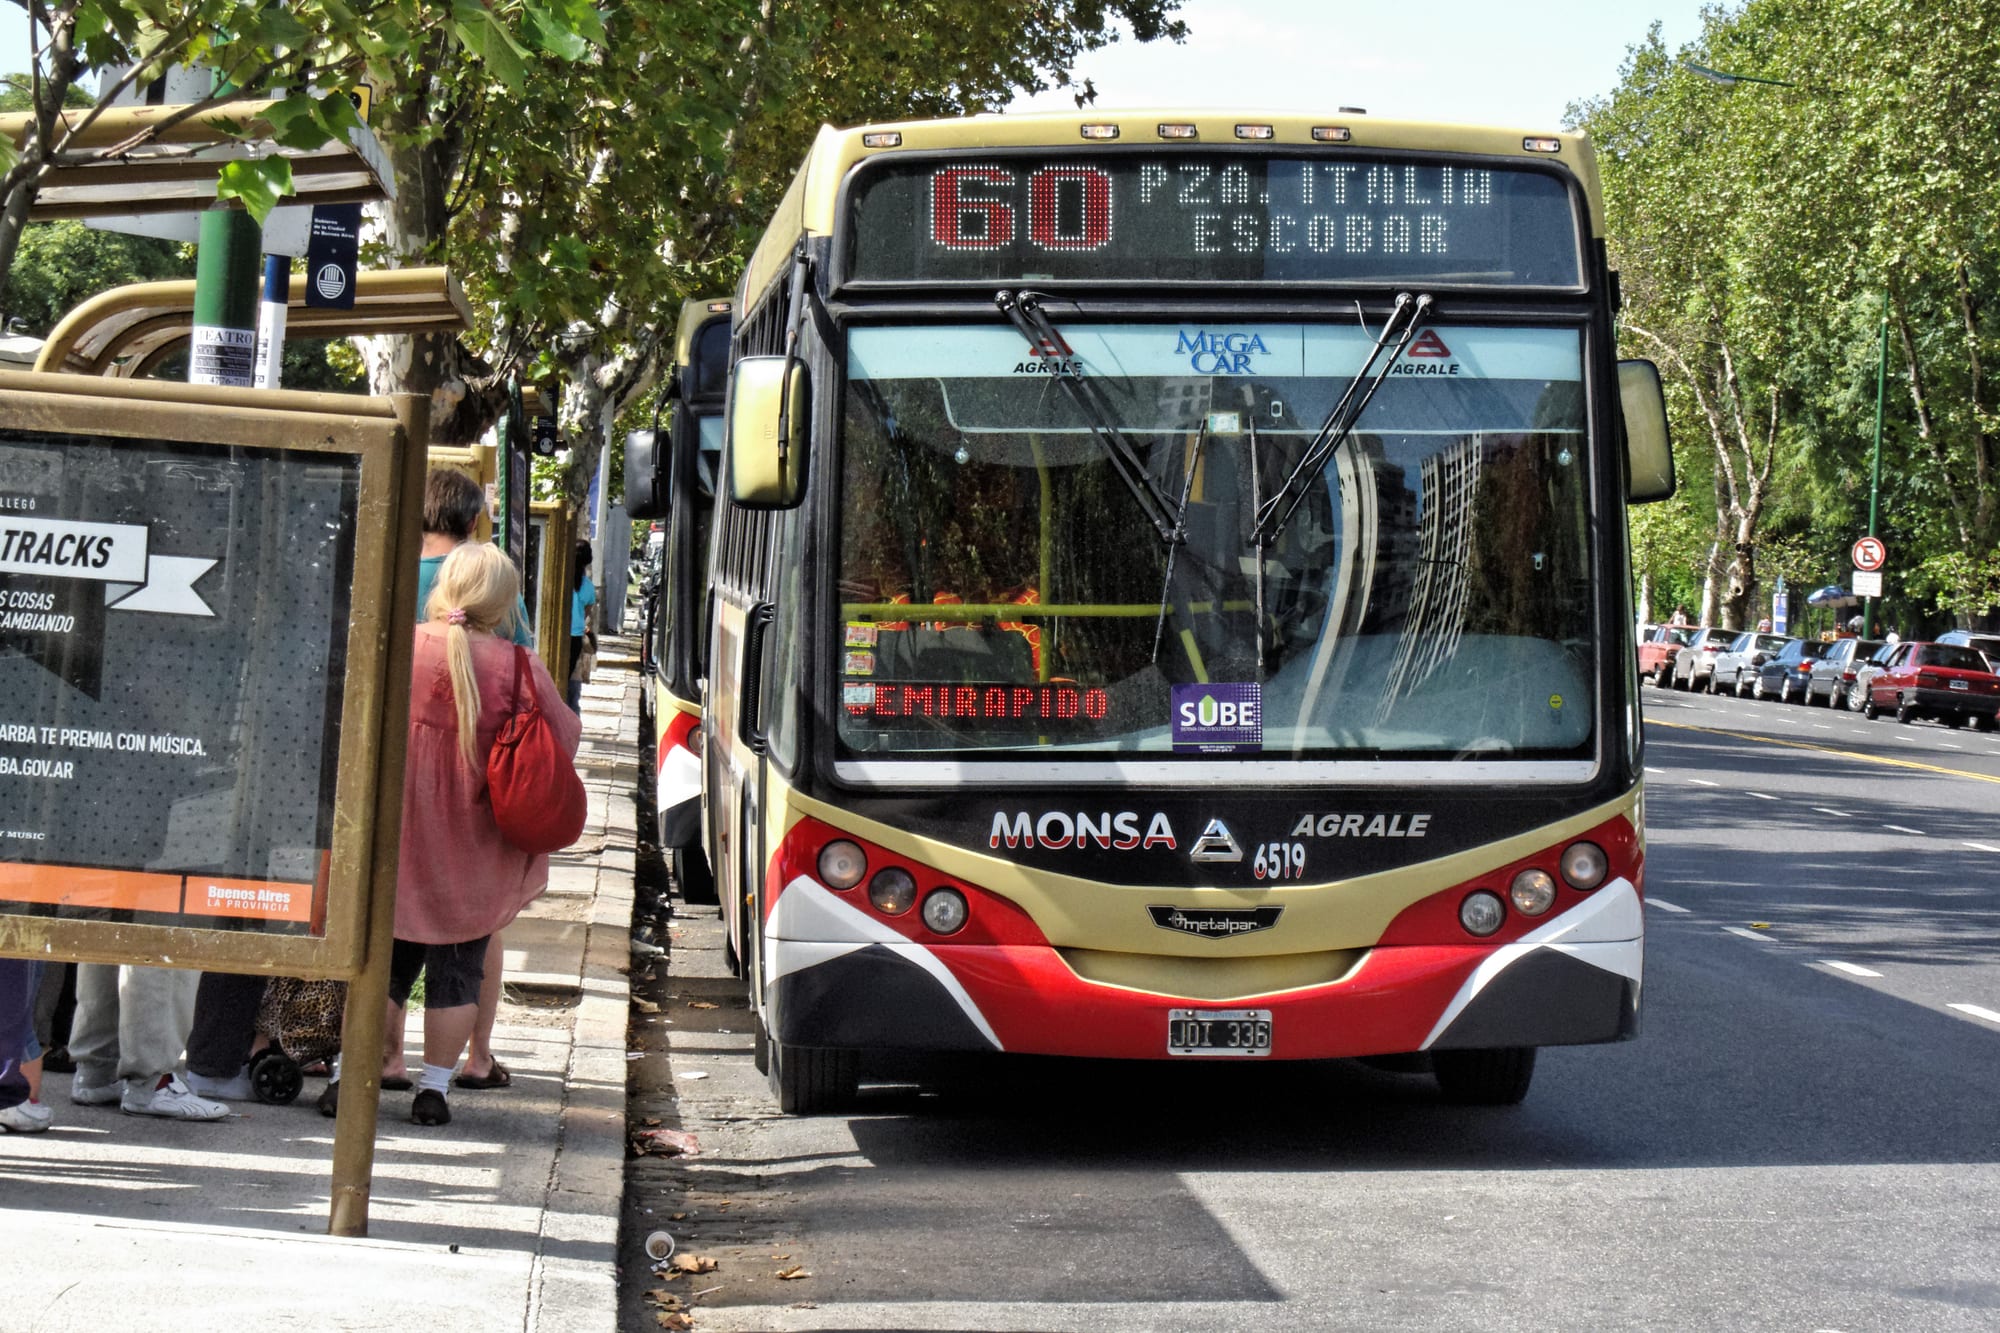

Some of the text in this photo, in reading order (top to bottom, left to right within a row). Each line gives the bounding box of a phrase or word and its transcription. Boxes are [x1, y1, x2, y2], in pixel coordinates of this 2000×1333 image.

[1141, 165, 1491, 205] PZA. ITALIA
[931, 165, 1113, 251] 60
[1195, 214, 1448, 253] ESCOBAR
[1175, 330, 1271, 355] MEGA
[1191, 352, 1256, 375] CAR
[1391, 363, 1460, 375] AGRALE
[1, 530, 114, 569] TRACKS
[9, 591, 55, 611] COSAS
[1180, 702, 1256, 727] SUBE
[0, 724, 207, 756] ARBA TE PREMIA CON MÚSICA.
[6, 830, 46, 840] MUSIC
[989, 811, 1177, 850] MONSA
[1291, 814, 1432, 837] AGRALE
[1254, 842, 1306, 880] 6519
[207, 885, 291, 904] Buenos Aires
[207, 898, 290, 913] LA PROVINCIA
[1181, 916, 1258, 934] metalpar
[1226, 1021, 1270, 1048] 336
